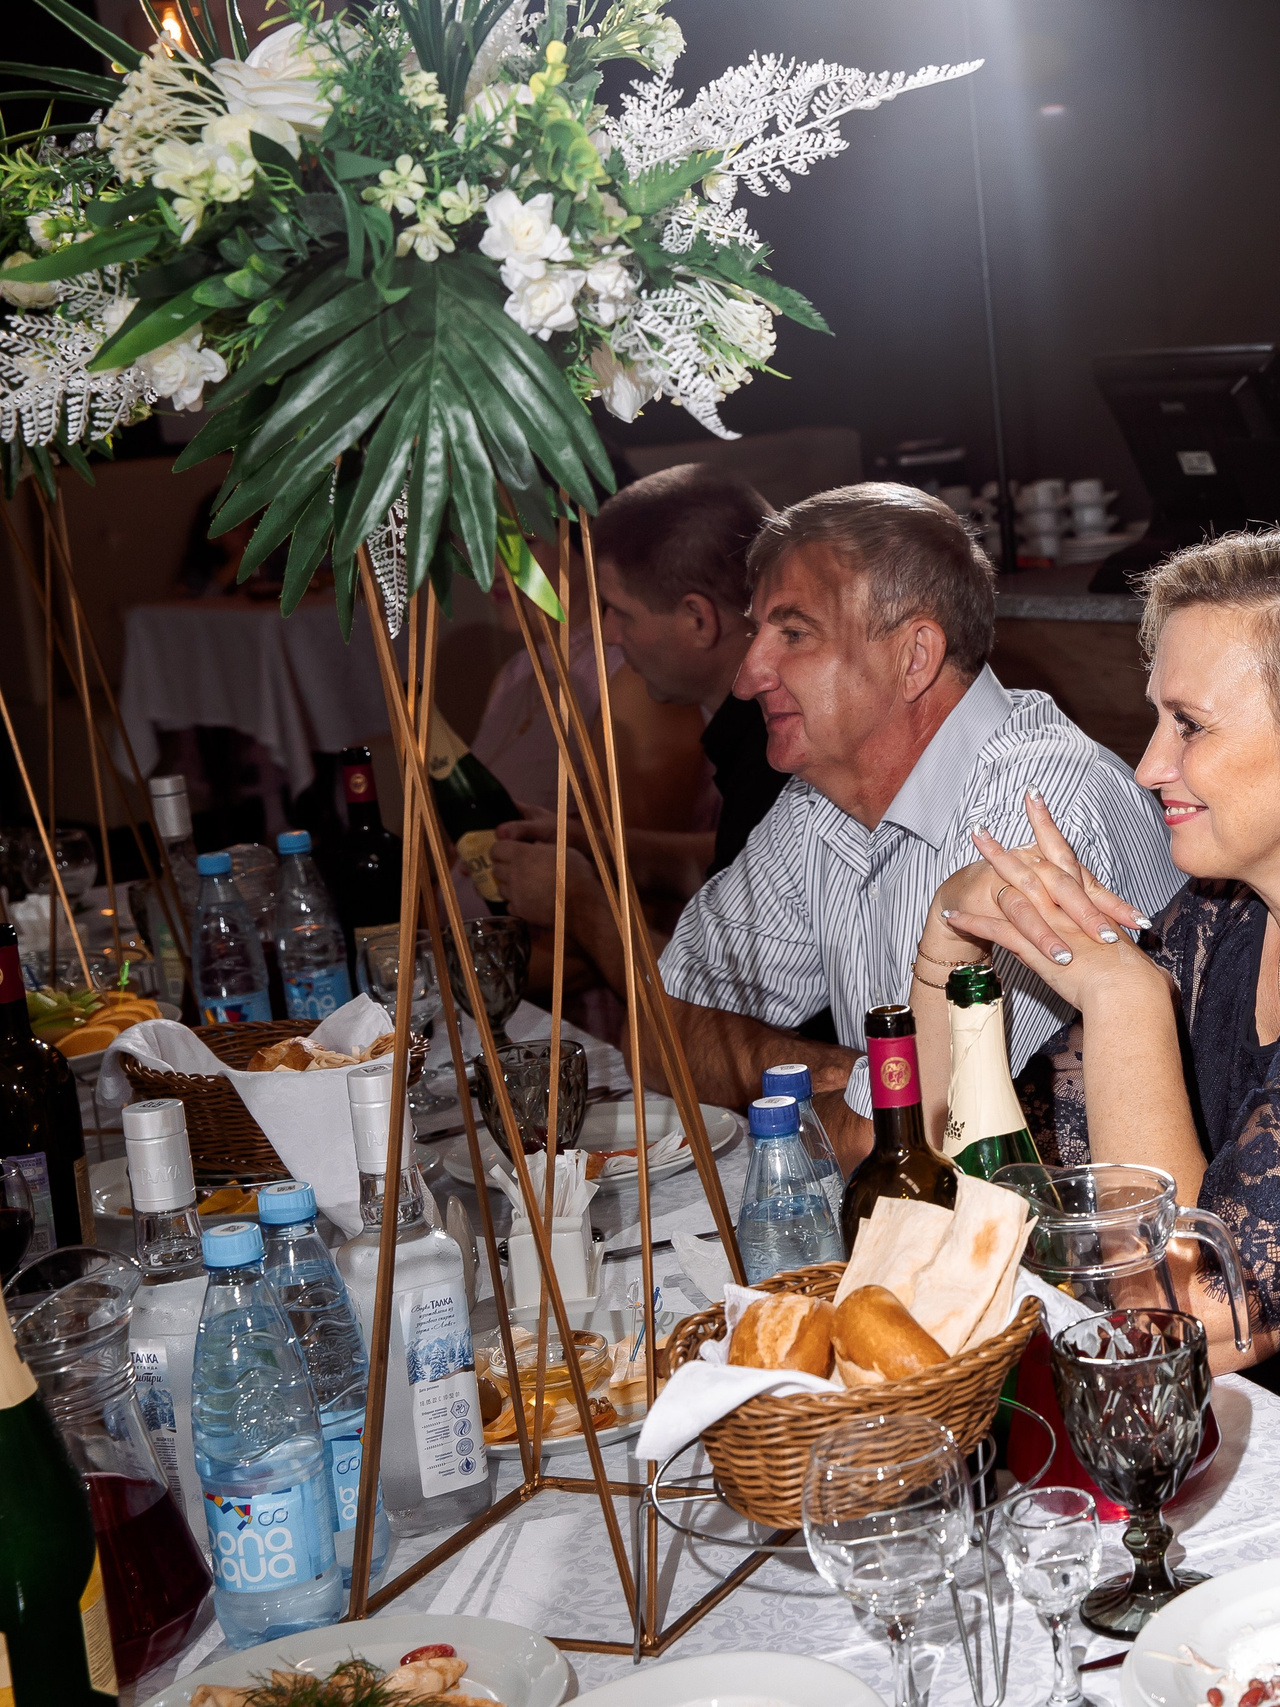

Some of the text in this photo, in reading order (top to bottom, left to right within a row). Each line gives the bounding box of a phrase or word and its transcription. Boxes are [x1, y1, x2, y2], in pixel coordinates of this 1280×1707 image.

[430, 1297, 453, 1309] ТАЛКА
[130, 1351, 159, 1364] ТАЛКА
[136, 1372, 164, 1386] ибири
